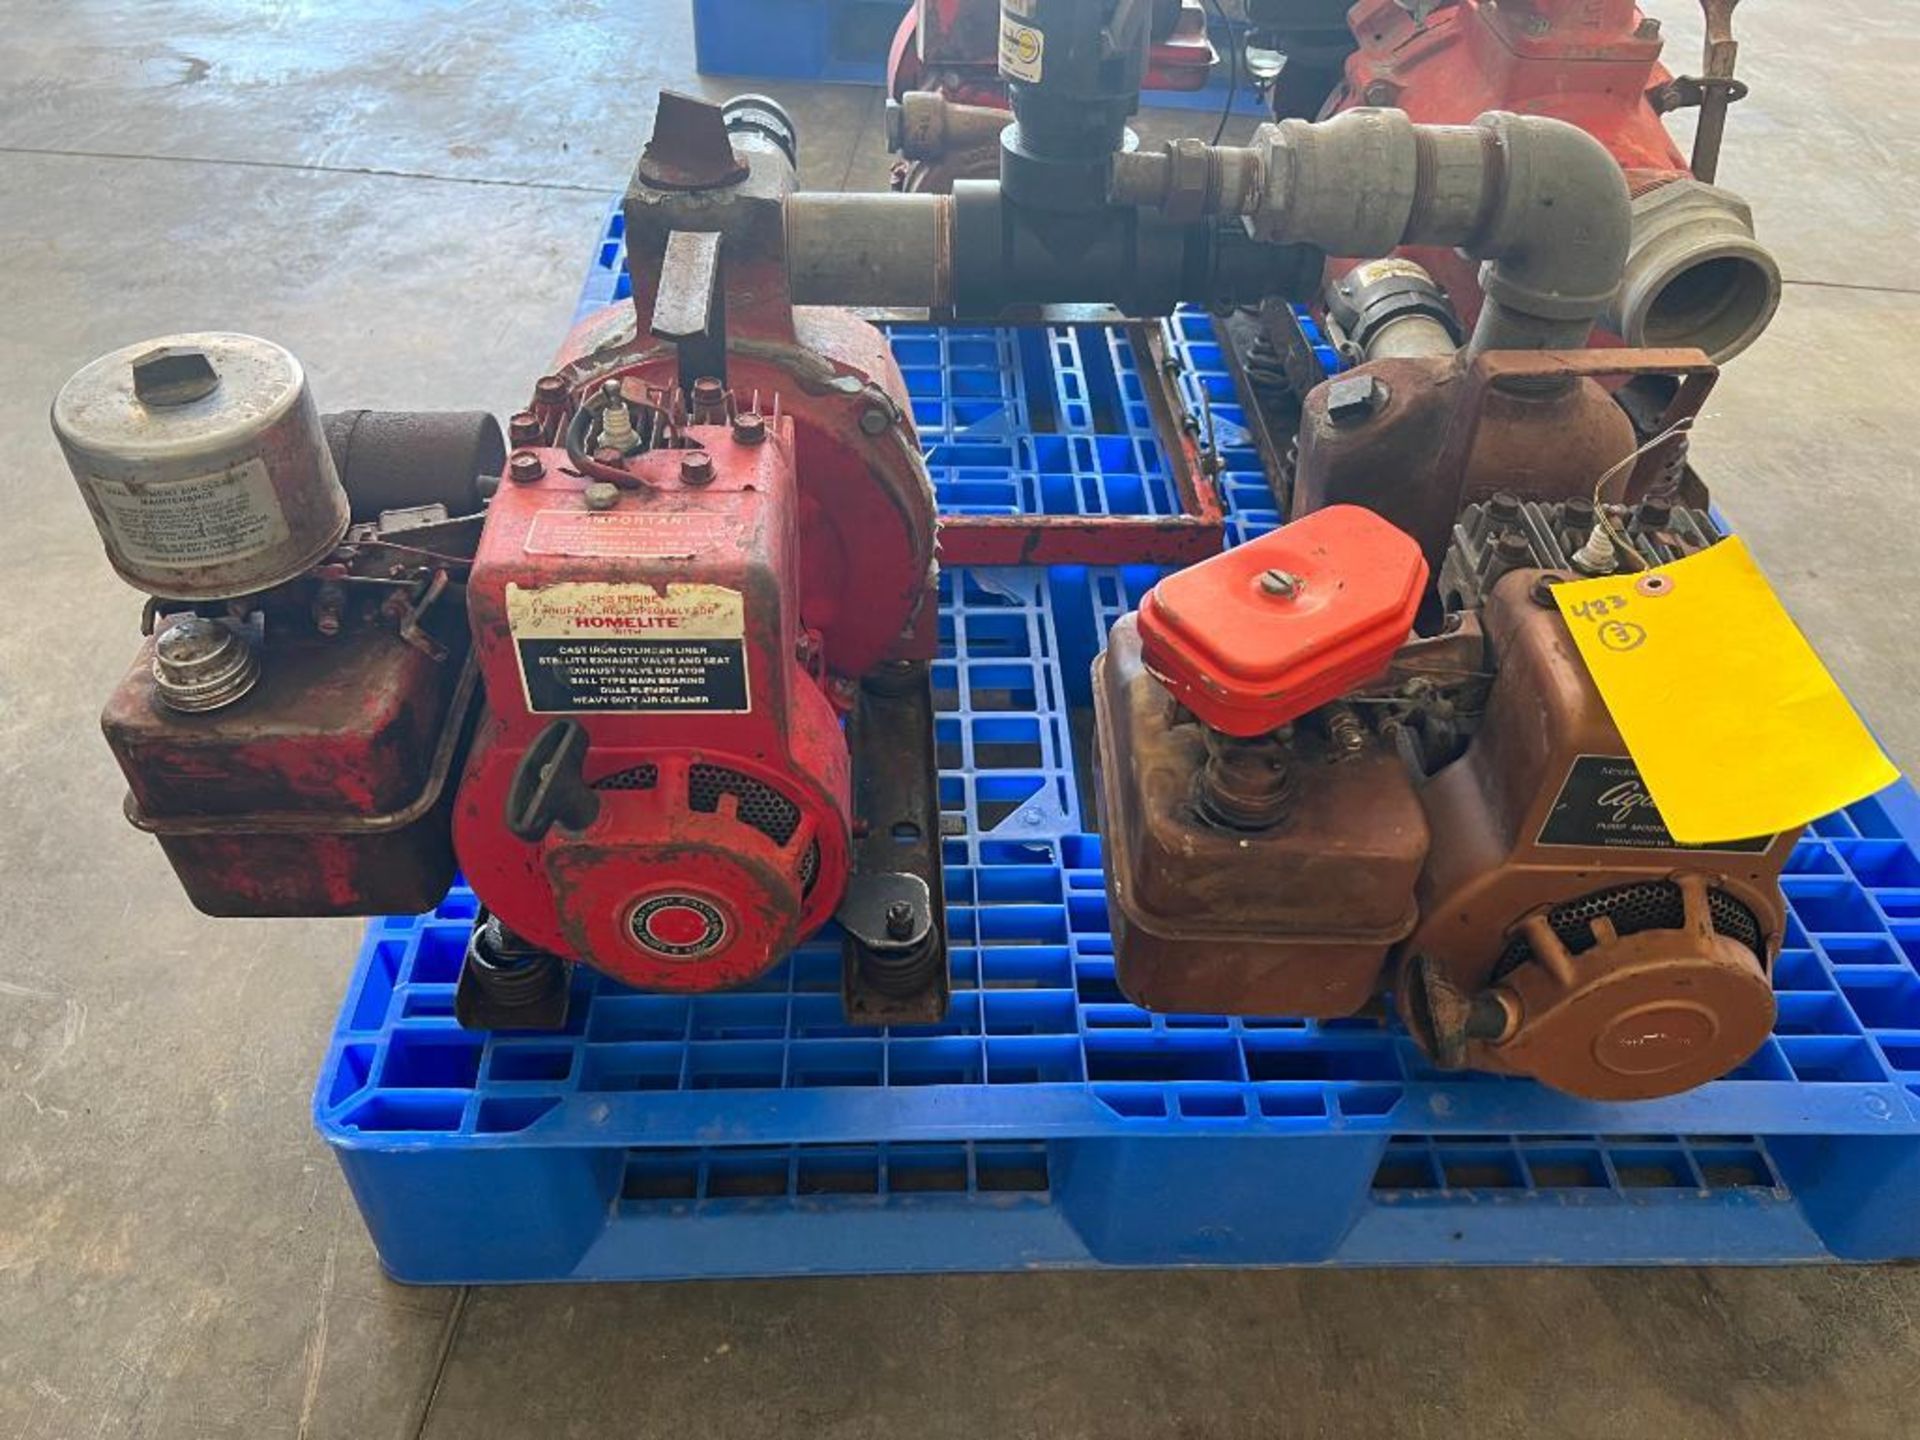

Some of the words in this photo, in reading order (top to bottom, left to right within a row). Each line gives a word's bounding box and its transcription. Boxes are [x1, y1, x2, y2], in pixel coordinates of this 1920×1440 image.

[1570, 594, 1628, 622] 483
[575, 617, 679, 628] HOMELITE
[559, 646, 587, 655] CAST
[589, 646, 617, 655] IRON
[675, 647, 707, 655] LINER
[538, 656, 588, 666] STELITE
[589, 656, 640, 665] EXHAUST
[642, 656, 677, 665] VALVE
[678, 656, 702, 665] AND
[703, 656, 731, 665] SEAT
[568, 667, 617, 676] EXHAUST
[618, 667, 654, 675] VALVE
[655, 667, 706, 675] ROTATOR
[570, 677, 598, 685] BALL
[600, 677, 627, 685] TYPE
[628, 677, 657, 685] MAIN
[658, 677, 706, 685] BEARING
[600, 686, 628, 694] DUAL
[630, 686, 680, 694] ELEMENT
[572, 695, 610, 704] HEAVY
[610, 695, 640, 704] DUTY
[641, 695, 659, 704] AIR
[660, 695, 710, 704] CLEANER
